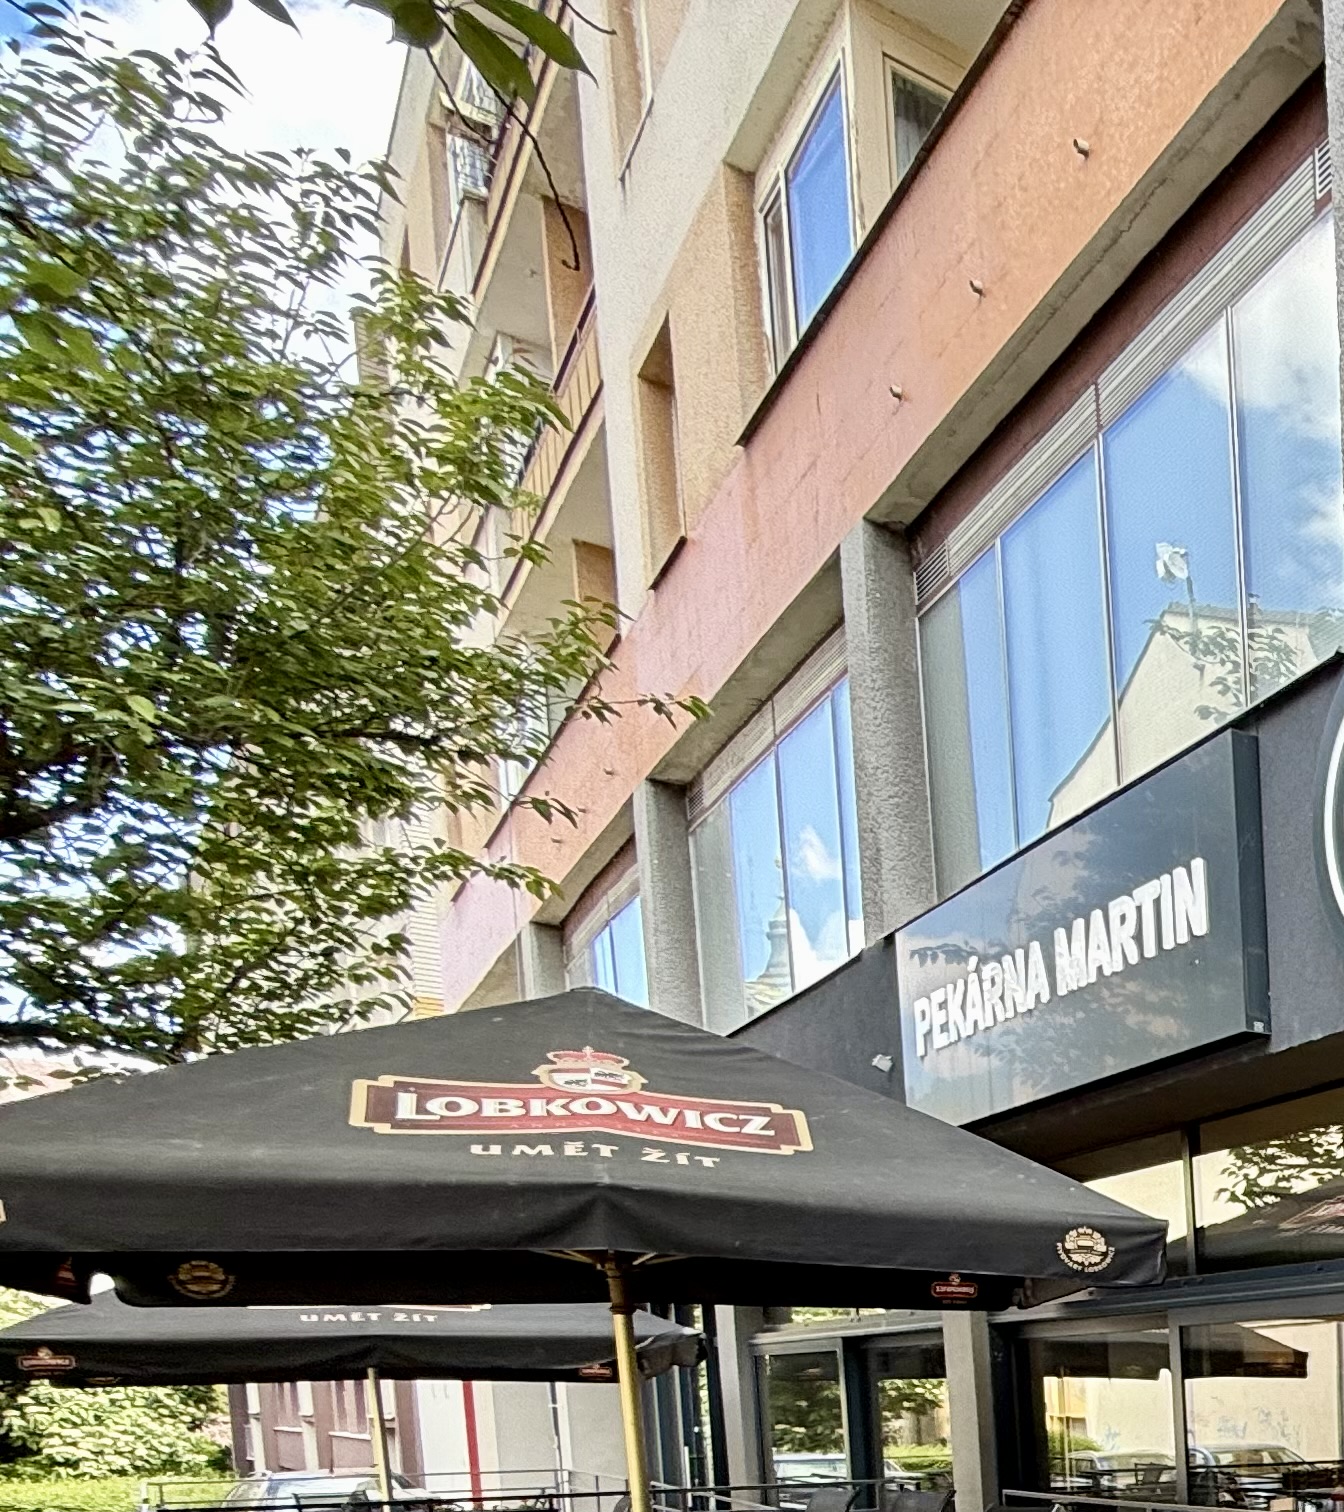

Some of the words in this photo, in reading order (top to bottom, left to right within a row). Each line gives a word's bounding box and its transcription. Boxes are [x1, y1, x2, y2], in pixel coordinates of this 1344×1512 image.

[914, 940, 1050, 1057] PEKÁRNA
[1054, 857, 1210, 997] MARTIN
[395, 1089, 776, 1136] LOBKOWICZ
[470, 1140, 619, 1158] UMĚT
[641, 1146, 721, 1168] ŽÍT
